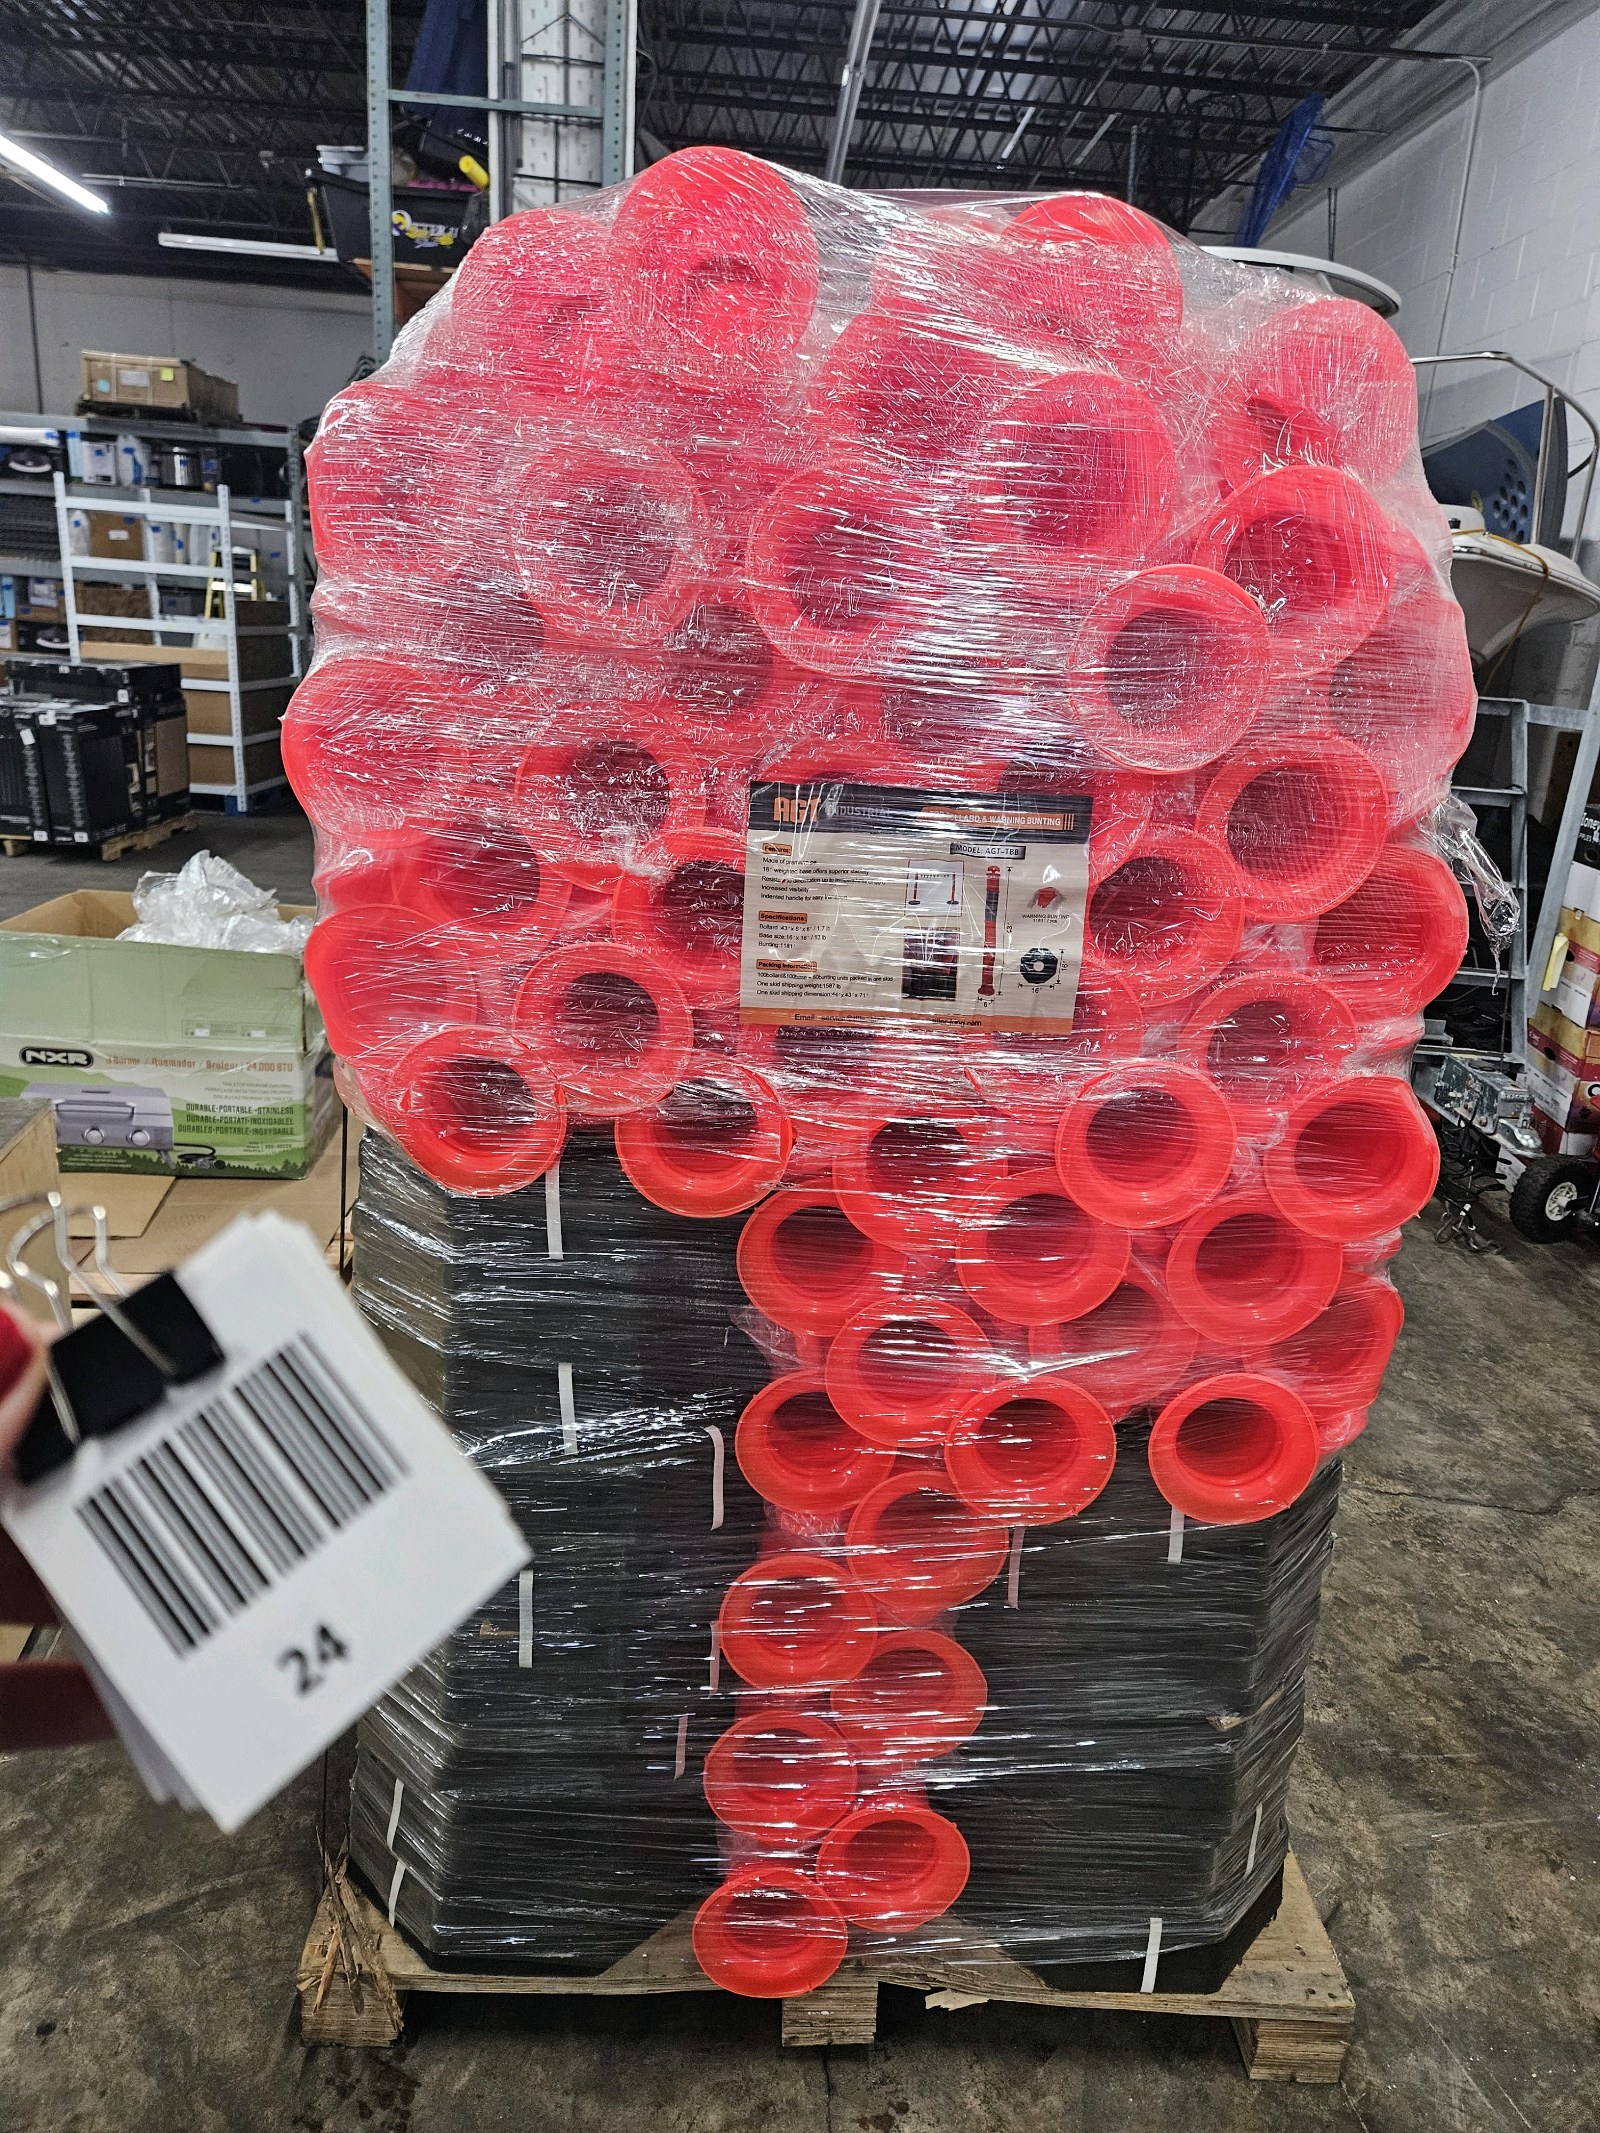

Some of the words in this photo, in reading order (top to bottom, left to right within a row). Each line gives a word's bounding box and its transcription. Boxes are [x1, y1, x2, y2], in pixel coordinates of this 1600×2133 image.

[774, 796, 821, 822] AGT
[989, 815, 1025, 825] WARNING
[1027, 818, 1061, 826] BUNTING
[955, 844, 983, 854] MODEL:
[985, 847, 1020, 856] AGT-TBB
[762, 884, 788, 892] Increased
[789, 886, 810, 894] visibility
[758, 961, 781, 969] Packing
[25, 1050, 89, 1065] NXR
[152, 1057, 196, 1069] Quemador
[277, 1062, 293, 1072] BTU
[275, 1623, 350, 1697] 24
